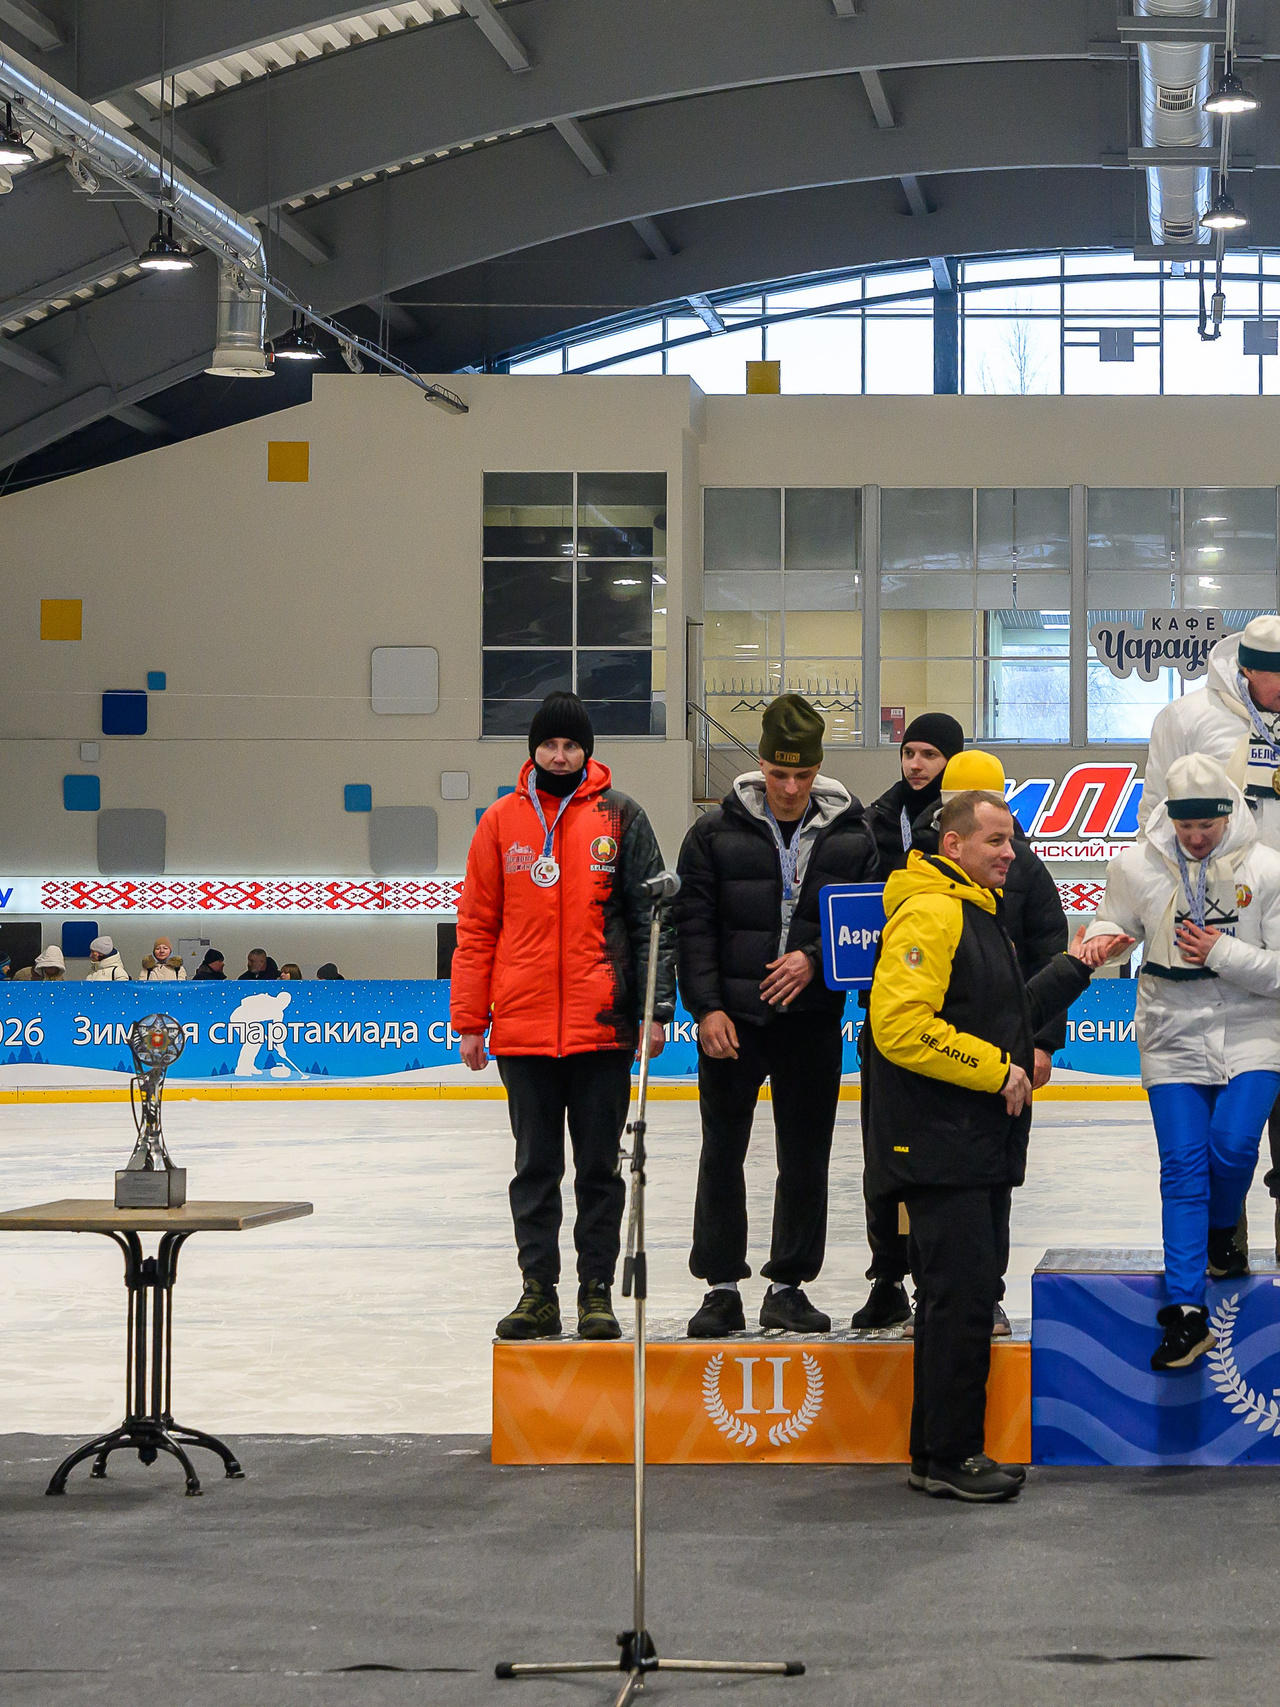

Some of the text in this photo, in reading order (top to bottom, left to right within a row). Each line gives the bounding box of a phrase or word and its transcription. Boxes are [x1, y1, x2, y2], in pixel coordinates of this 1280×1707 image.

[1152, 617, 1215, 631] КАФЕ
[1098, 629, 1228, 674] Чараўн
[0, 1016, 45, 1046] 26
[208, 1020, 418, 1051] спартакиада
[919, 1032, 980, 1069] BELARUS
[734, 1357, 792, 1414] II
